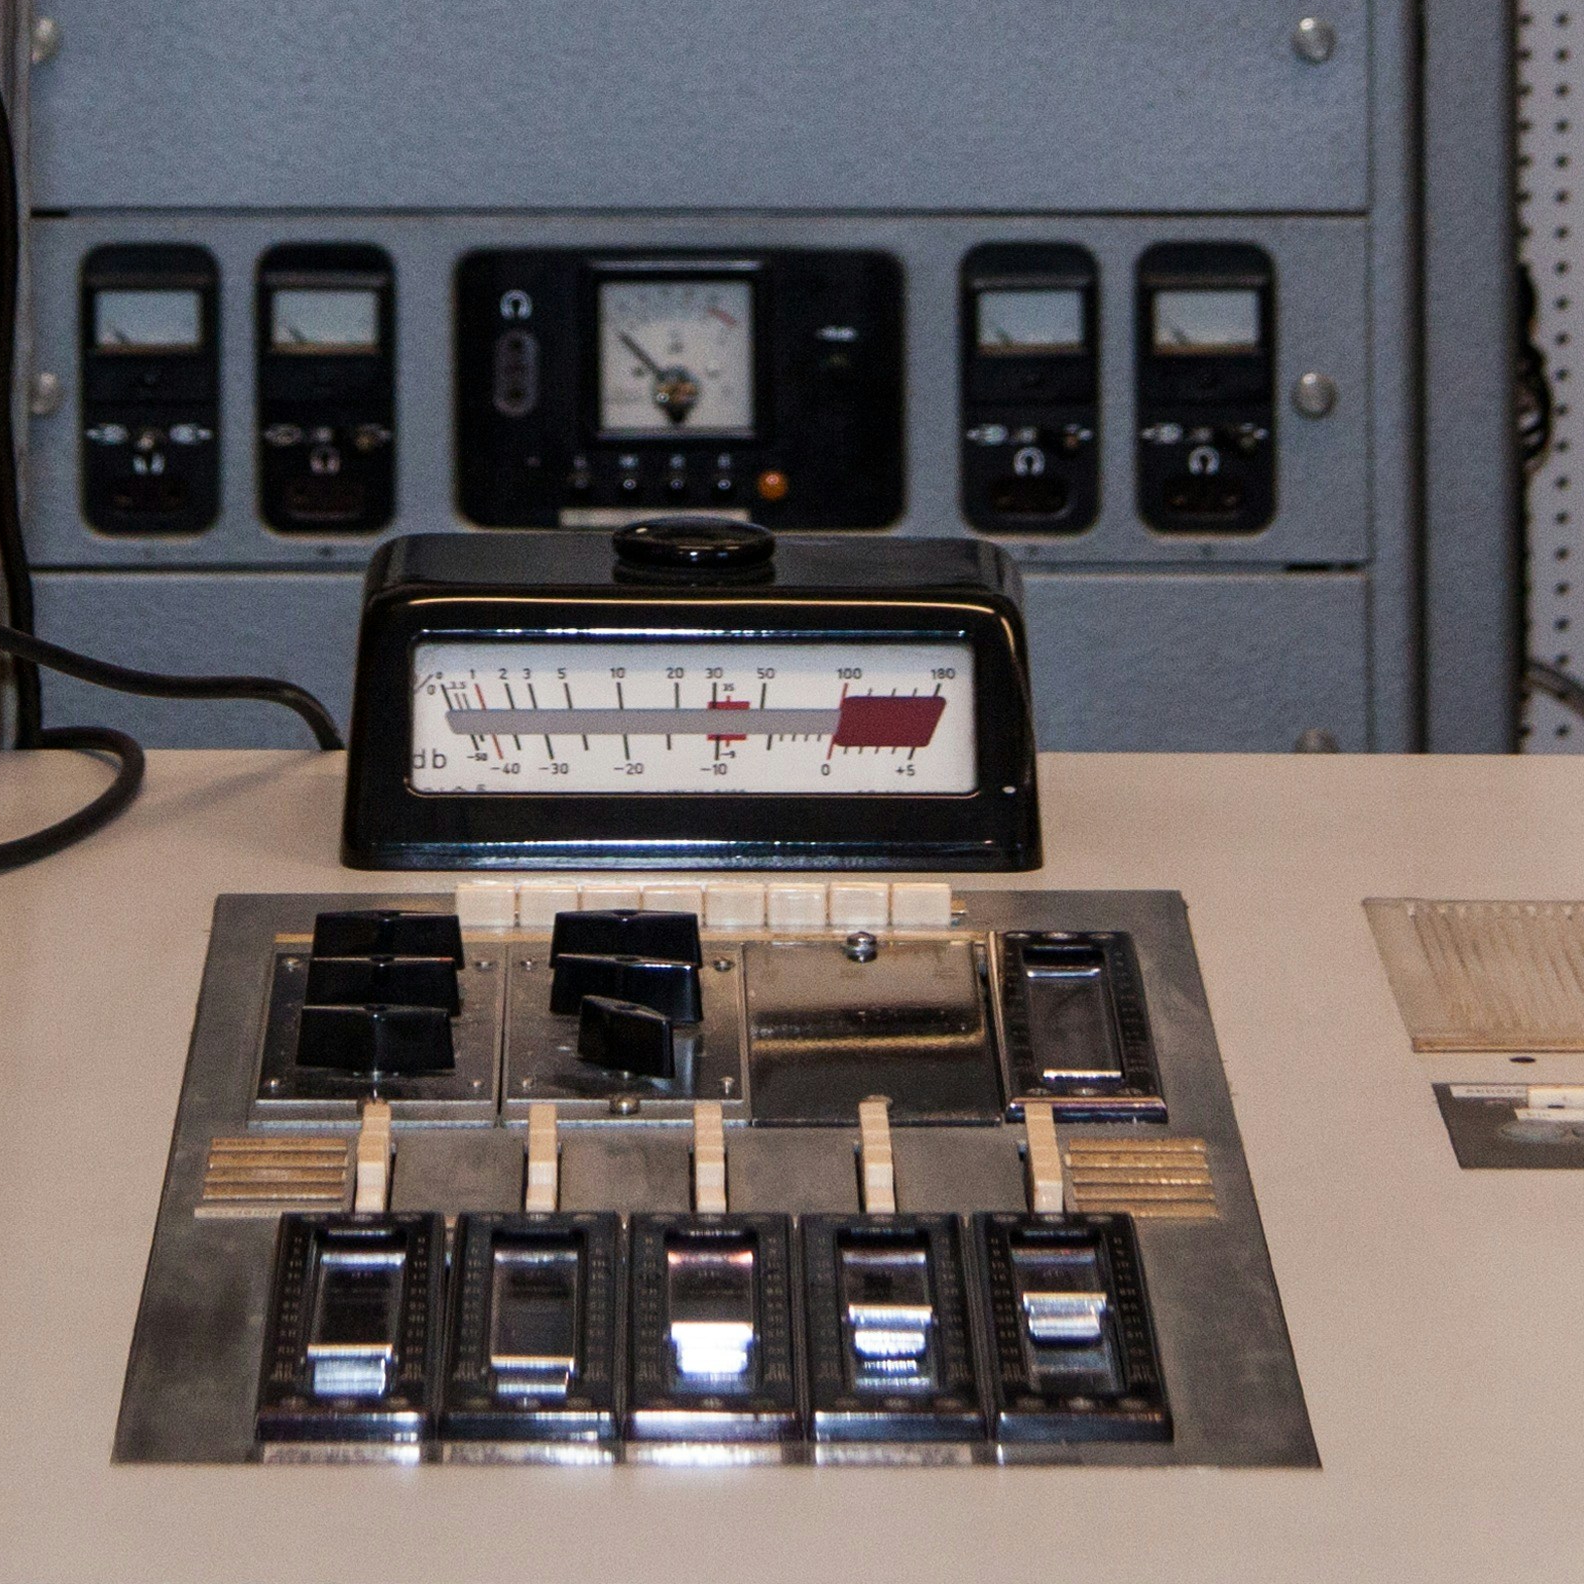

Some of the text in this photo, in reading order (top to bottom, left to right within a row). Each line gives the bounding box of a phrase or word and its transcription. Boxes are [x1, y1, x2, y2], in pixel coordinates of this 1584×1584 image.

[469, 668, 476, 680] 1
[499, 668, 509, 680] 2
[523, 668, 532, 680] 3
[557, 668, 567, 680] 5
[611, 667, 626, 679] 10
[667, 667, 684, 679] 20
[705, 667, 724, 680] 30
[757, 667, 775, 680] 50
[836, 667, 862, 680] 100
[930, 667, 956, 680] 180
[491, 763, 521, 775] -40
[538, 763, 569, 775] -30
[613, 763, 645, 775] -20
[700, 763, 728, 776] -10
[820, 764, 831, 777] 0
[895, 764, 916, 777] +5
